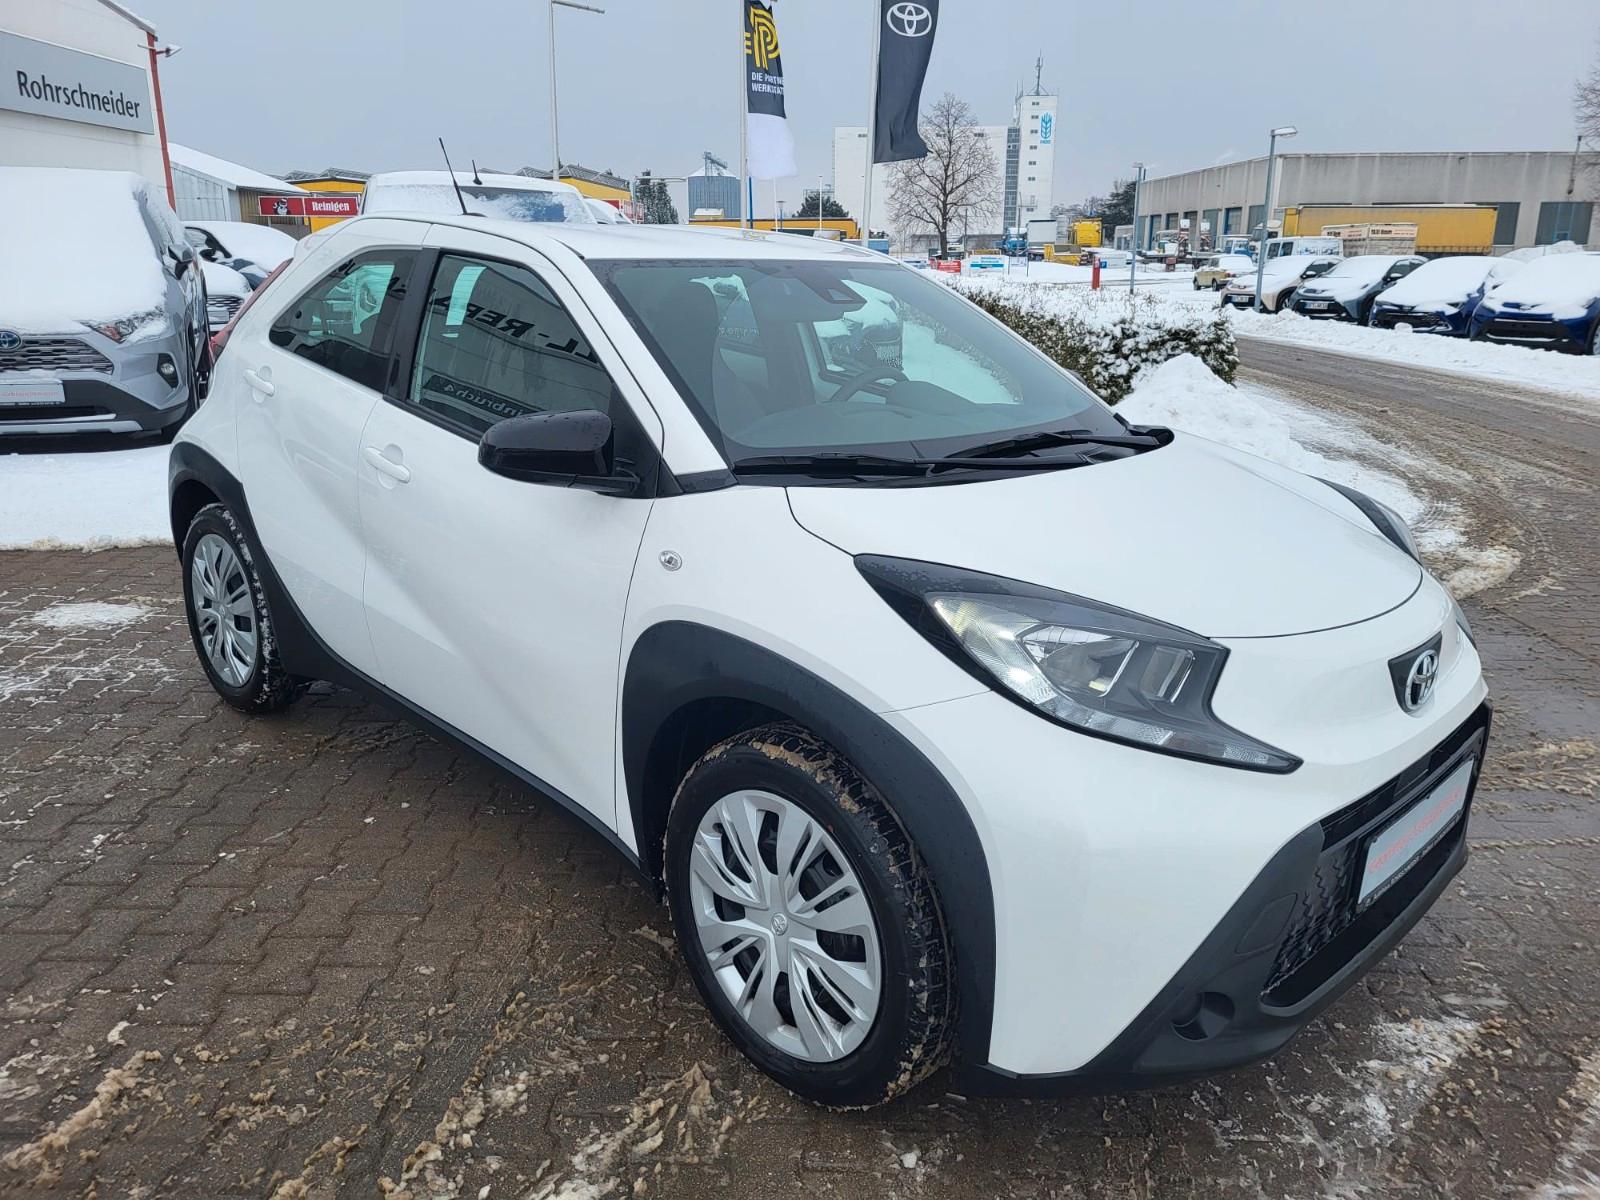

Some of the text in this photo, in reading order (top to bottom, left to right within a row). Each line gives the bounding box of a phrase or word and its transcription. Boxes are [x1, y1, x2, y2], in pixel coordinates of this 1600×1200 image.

[751, 71, 763, 82] DIE
[16, 70, 140, 119] Rohrschneider
[312, 201, 350, 213] Reinigen
